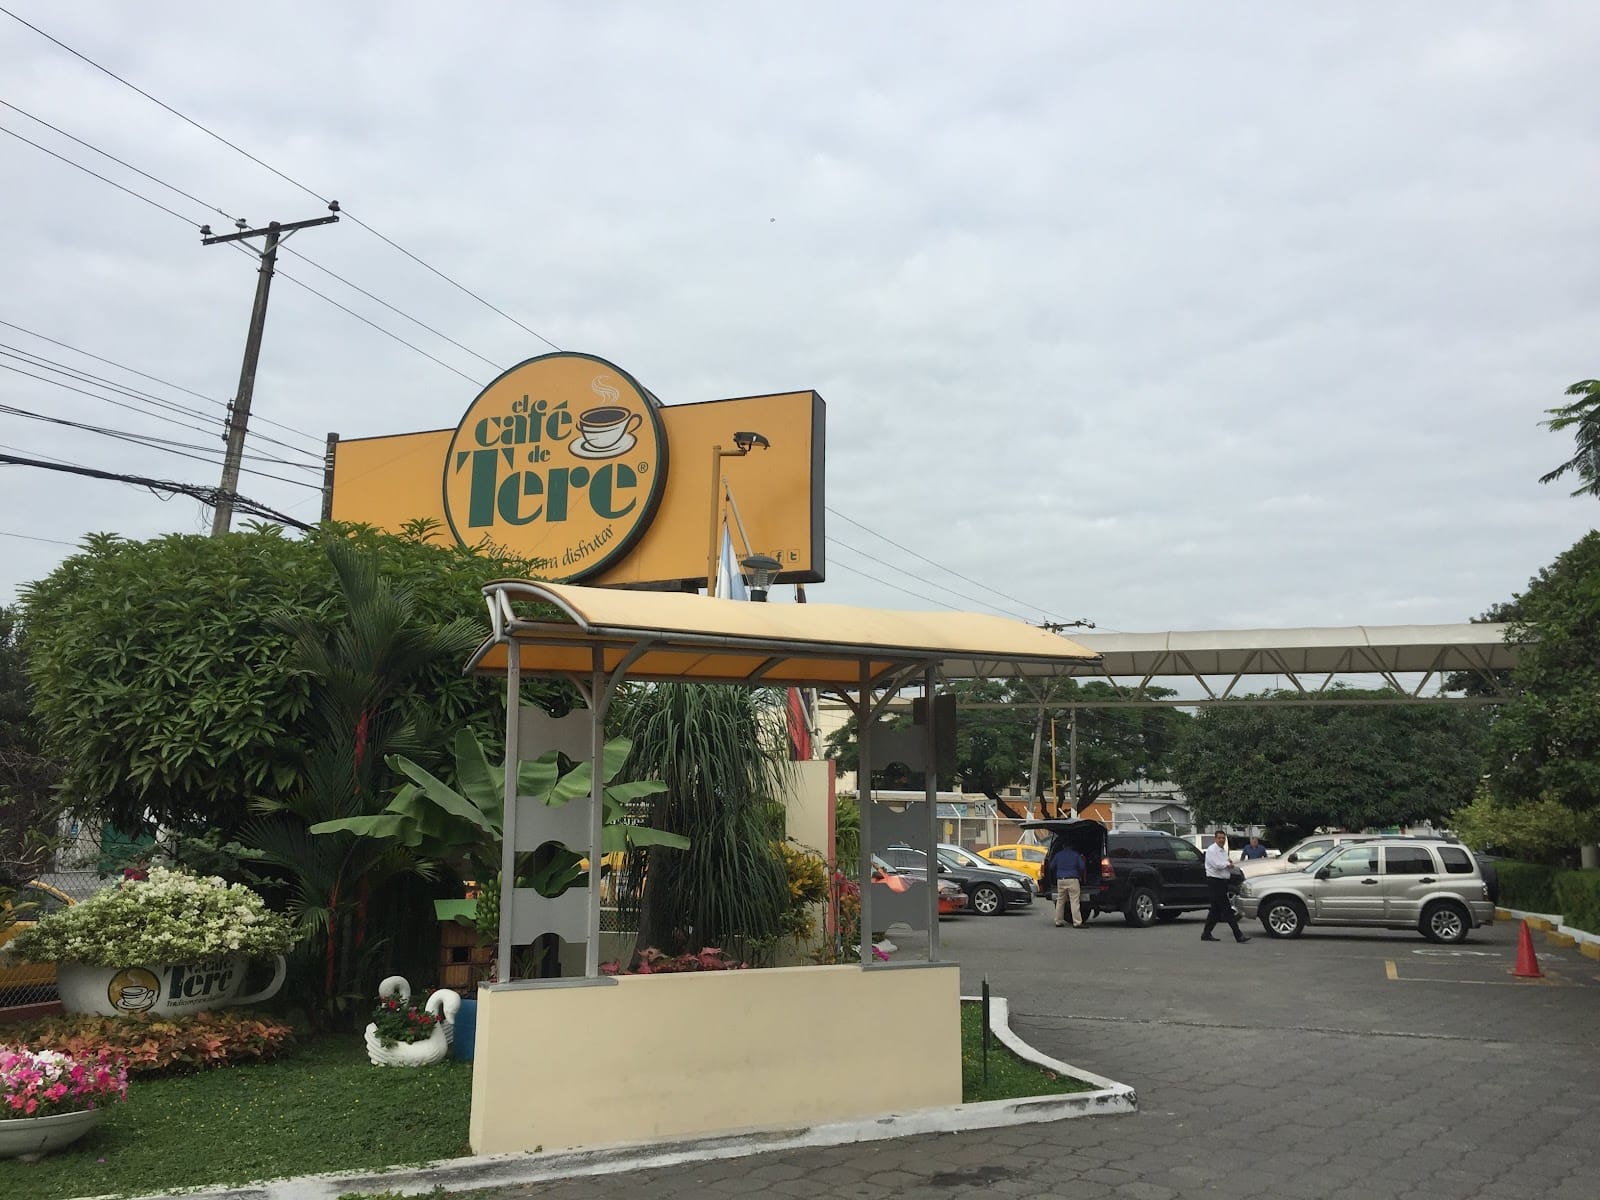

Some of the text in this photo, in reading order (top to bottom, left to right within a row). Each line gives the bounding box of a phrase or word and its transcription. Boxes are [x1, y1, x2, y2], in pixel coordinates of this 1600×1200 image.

[474, 399, 573, 448] café
[511, 394, 529, 414] el
[527, 444, 551, 464] de
[455, 447, 638, 529] Tere
[562, 523, 613, 567] disfrutar
[163, 964, 233, 1000] Tere
